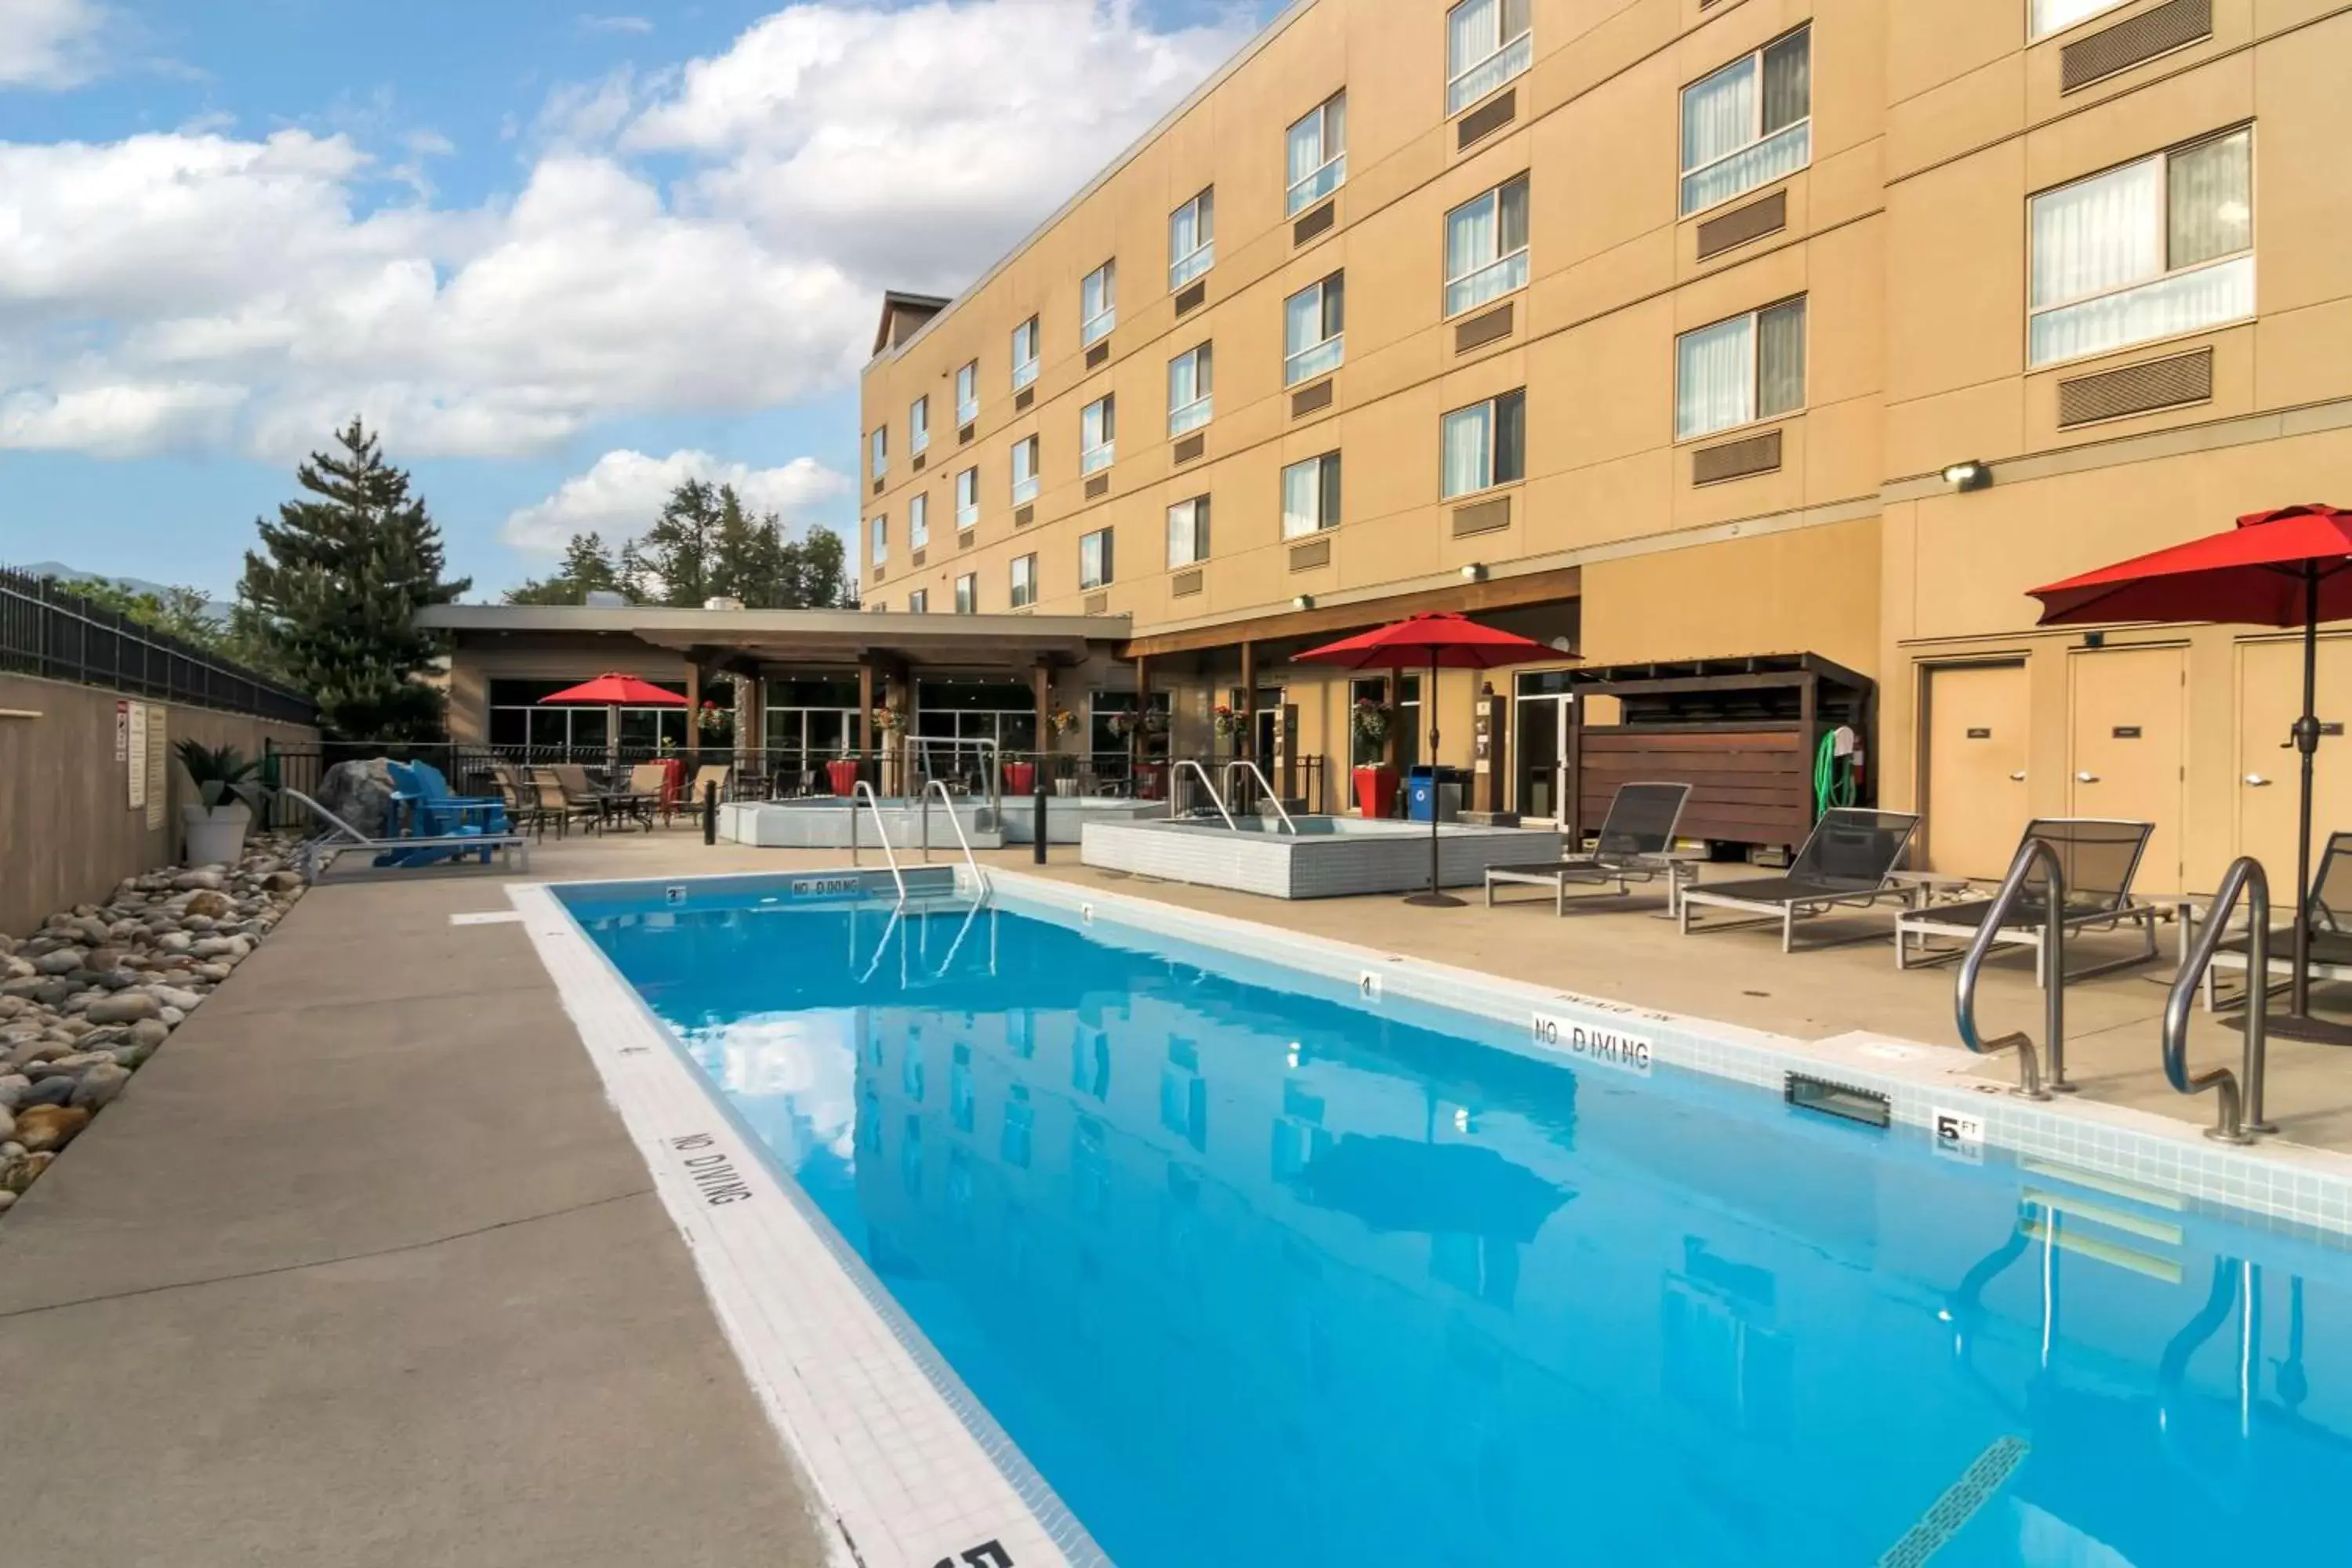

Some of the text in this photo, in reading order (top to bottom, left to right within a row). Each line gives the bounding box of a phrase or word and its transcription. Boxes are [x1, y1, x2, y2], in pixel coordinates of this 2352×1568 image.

[1534, 1018, 1558, 1044] NO
[1937, 1116, 1959, 1140] 5
[670, 1133, 753, 1206] NO DIVING
